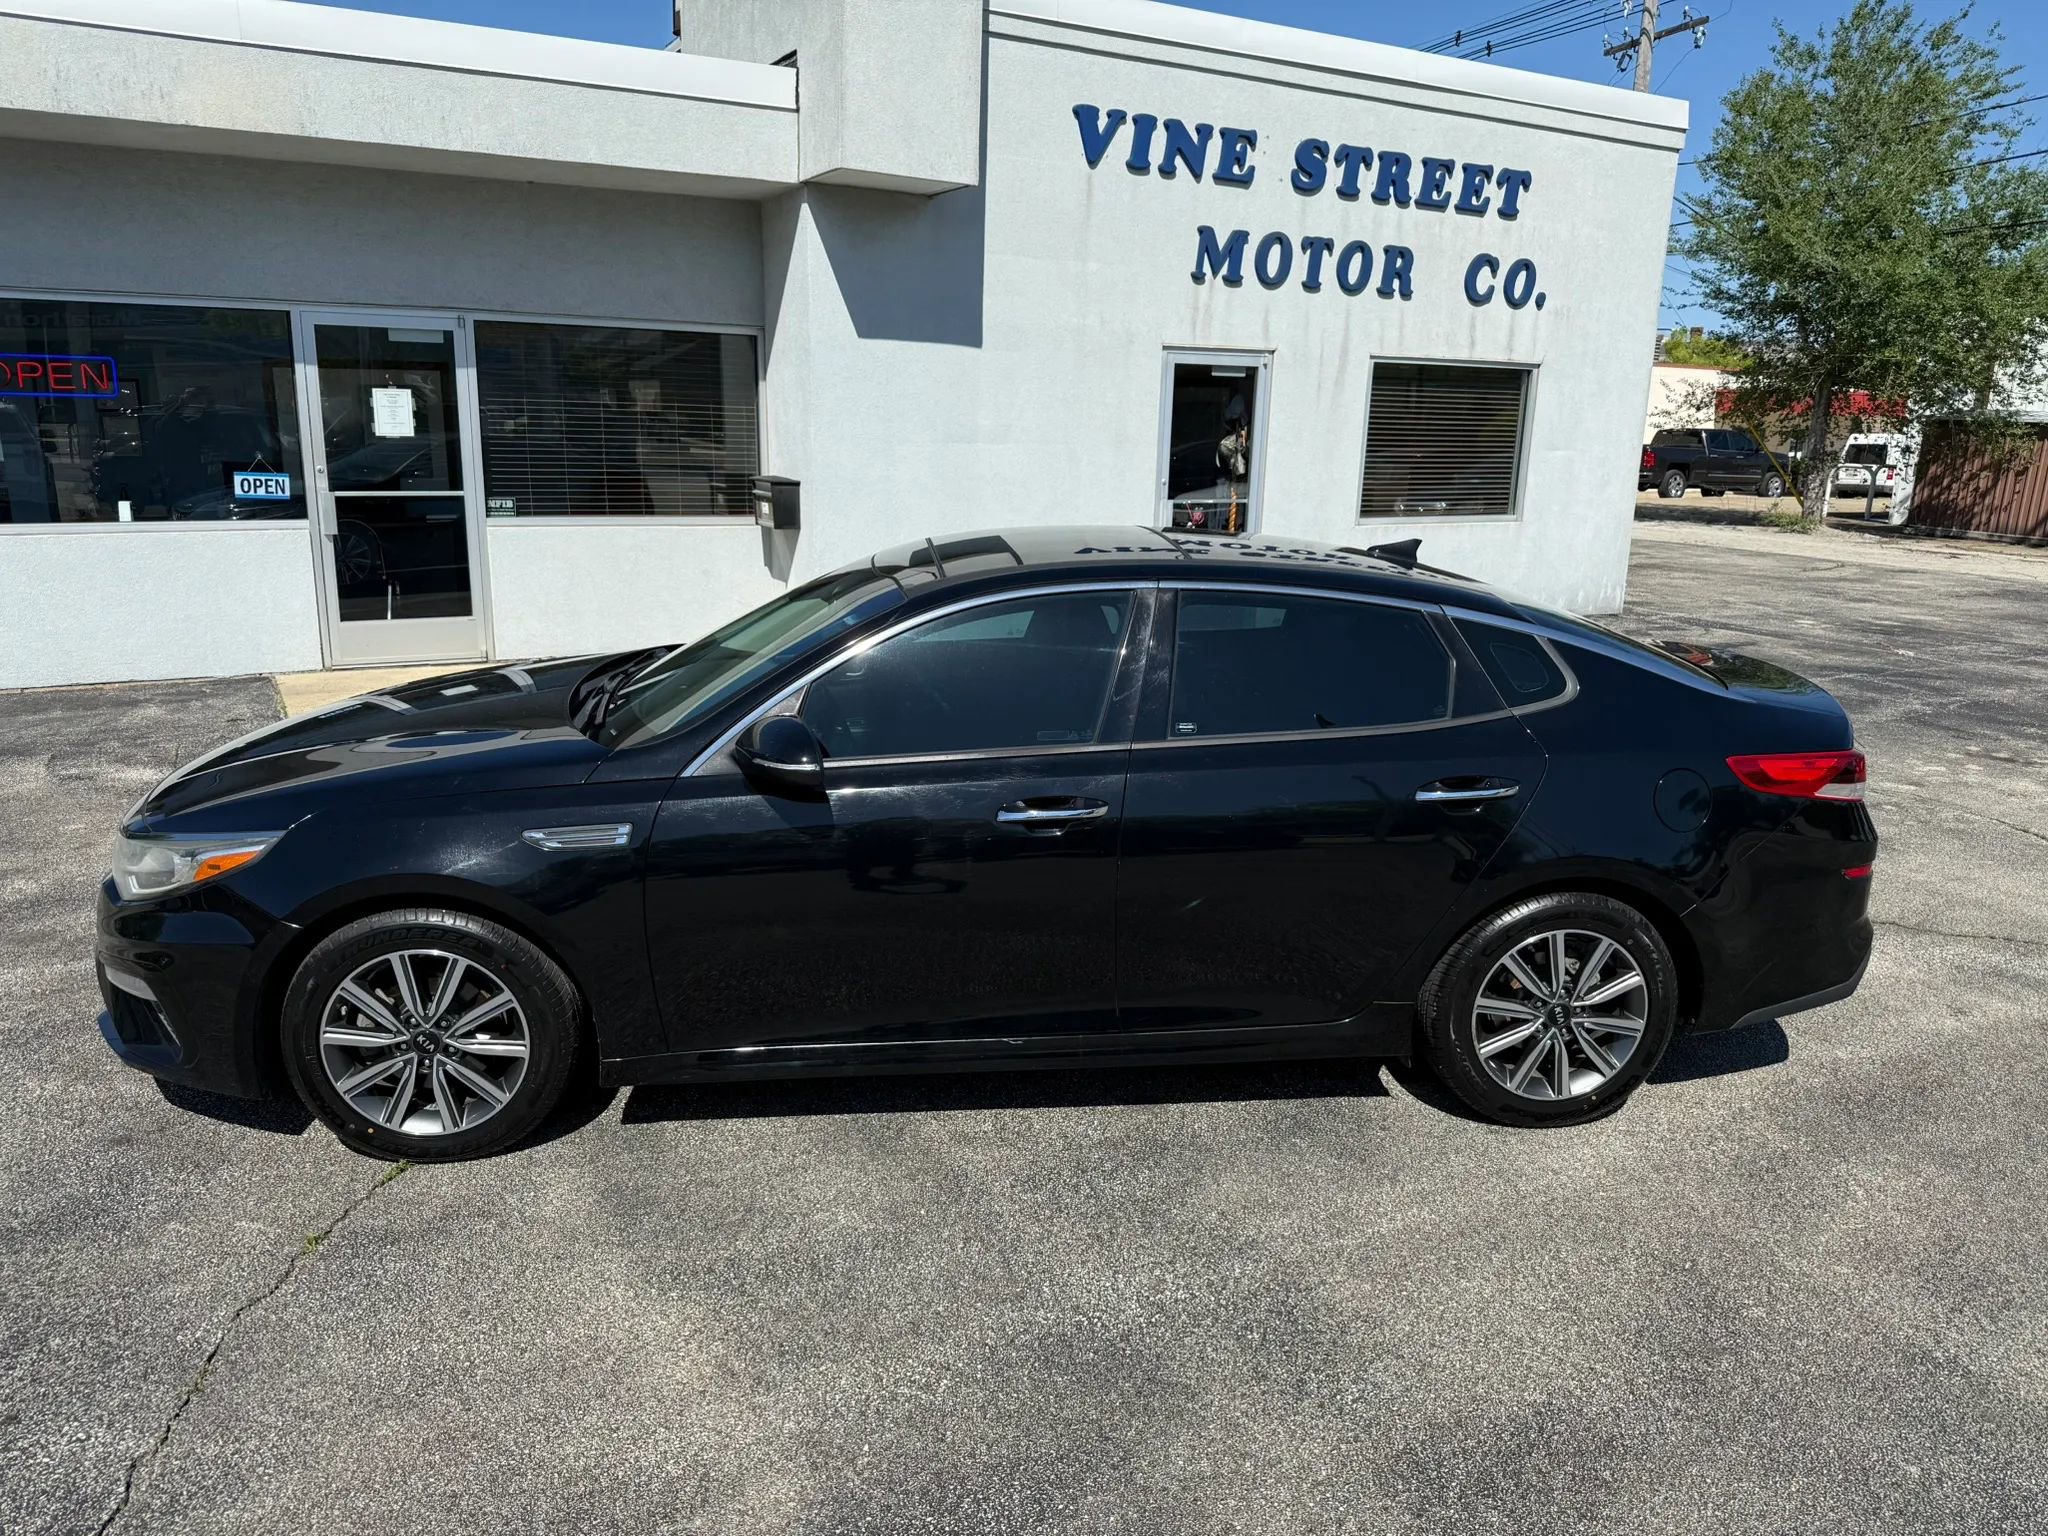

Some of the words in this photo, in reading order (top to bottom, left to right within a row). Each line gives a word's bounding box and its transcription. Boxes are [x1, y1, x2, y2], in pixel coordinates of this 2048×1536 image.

[1072, 103, 1257, 189] VINE
[1290, 137, 1532, 221] STREET
[1191, 225, 1415, 301] MOTOR
[1463, 253, 1547, 311] CO.
[240, 477, 286, 495] OPEN
[1554, 1006, 1565, 1024] KIA
[416, 1034, 435, 1052] KIA
